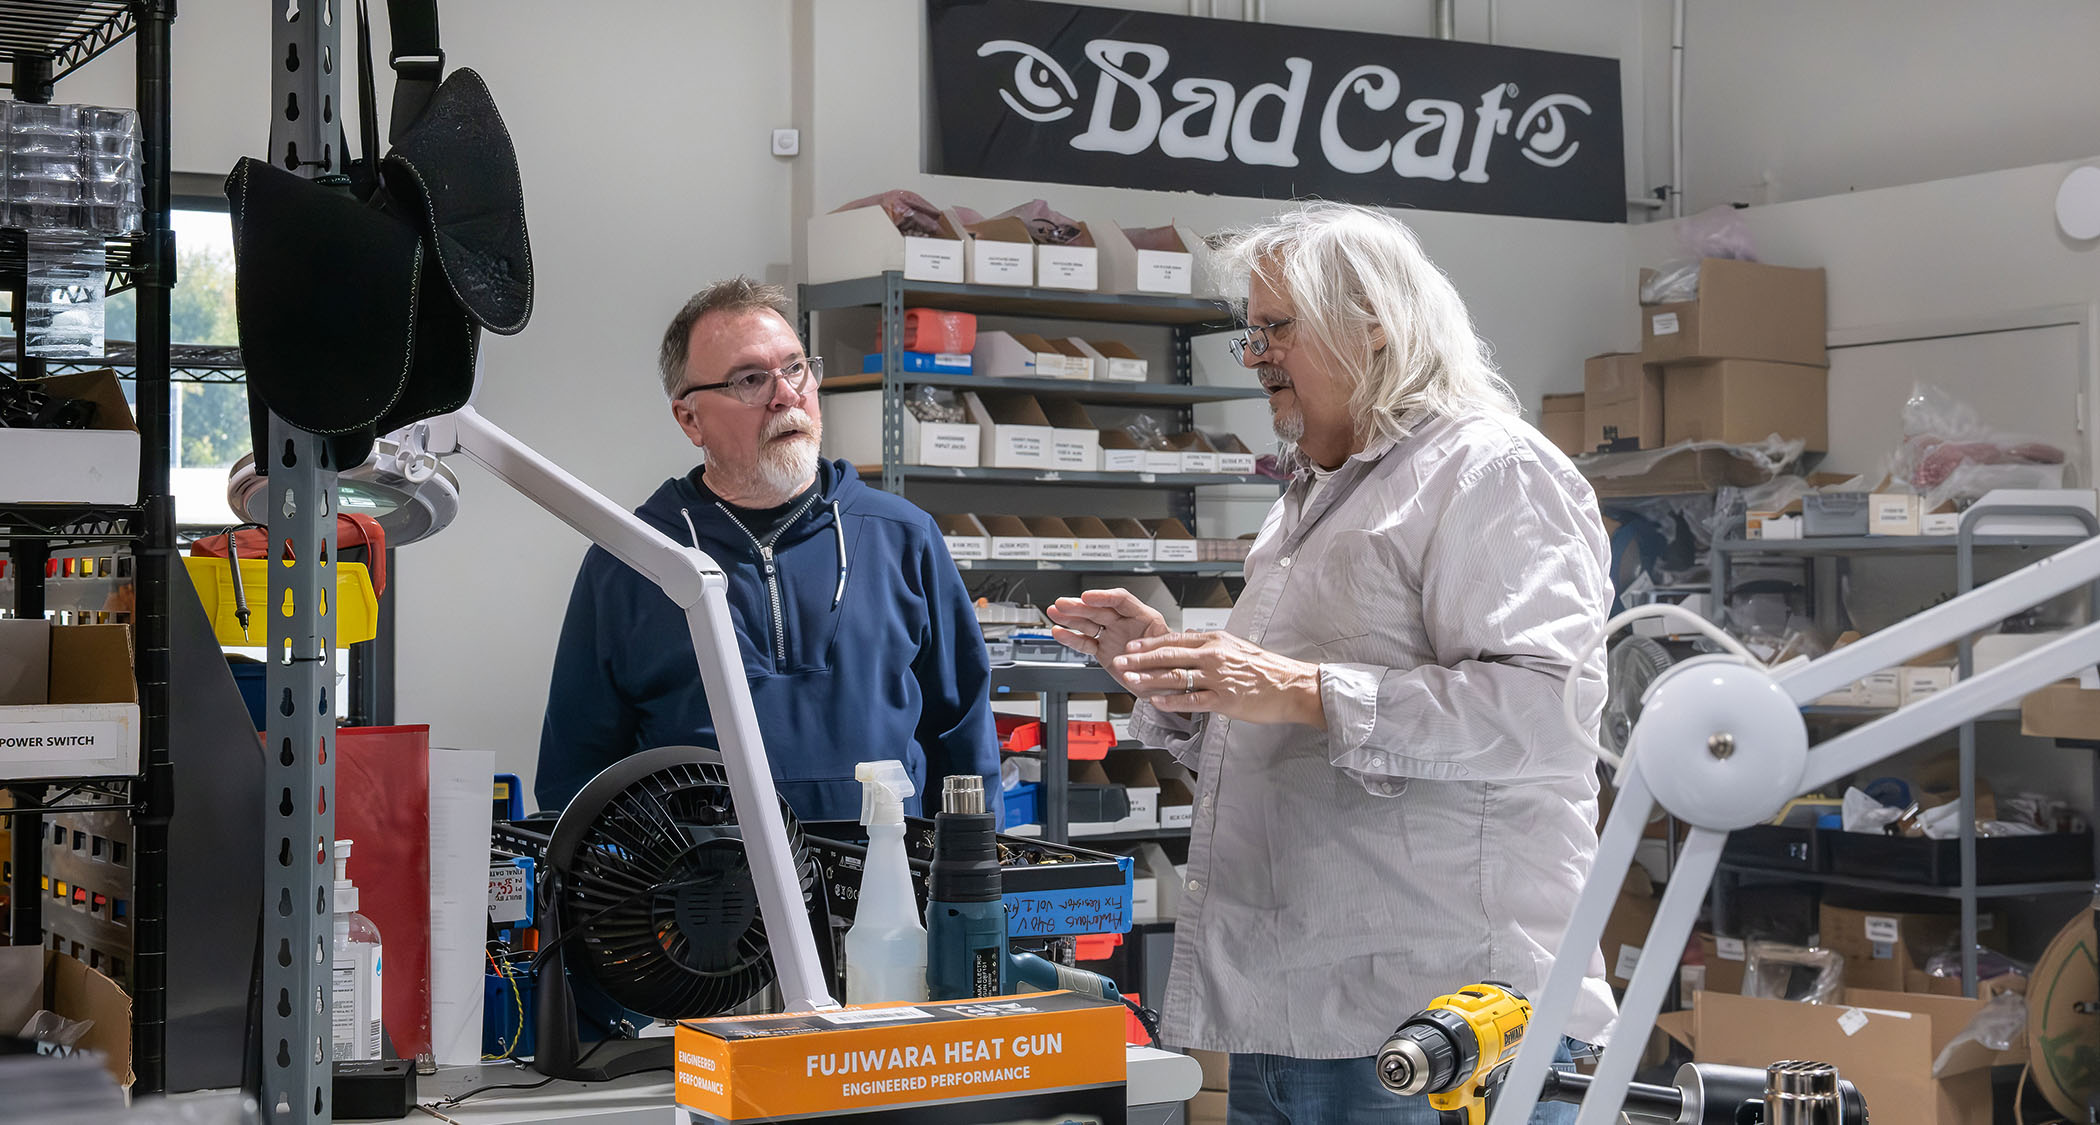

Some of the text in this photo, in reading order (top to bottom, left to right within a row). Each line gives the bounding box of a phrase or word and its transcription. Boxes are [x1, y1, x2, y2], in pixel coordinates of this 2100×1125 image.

[1069, 39, 1312, 167] Bad
[0, 736, 94, 748] POWER SWITCH
[678, 1050, 716, 1071] ENGINEERED
[807, 1032, 1063, 1077] FUJIWARA HEAT GUN
[678, 1071, 724, 1096] PERFORMANCE
[842, 1066, 1031, 1097] ENGINEERED PERFORMANCE
